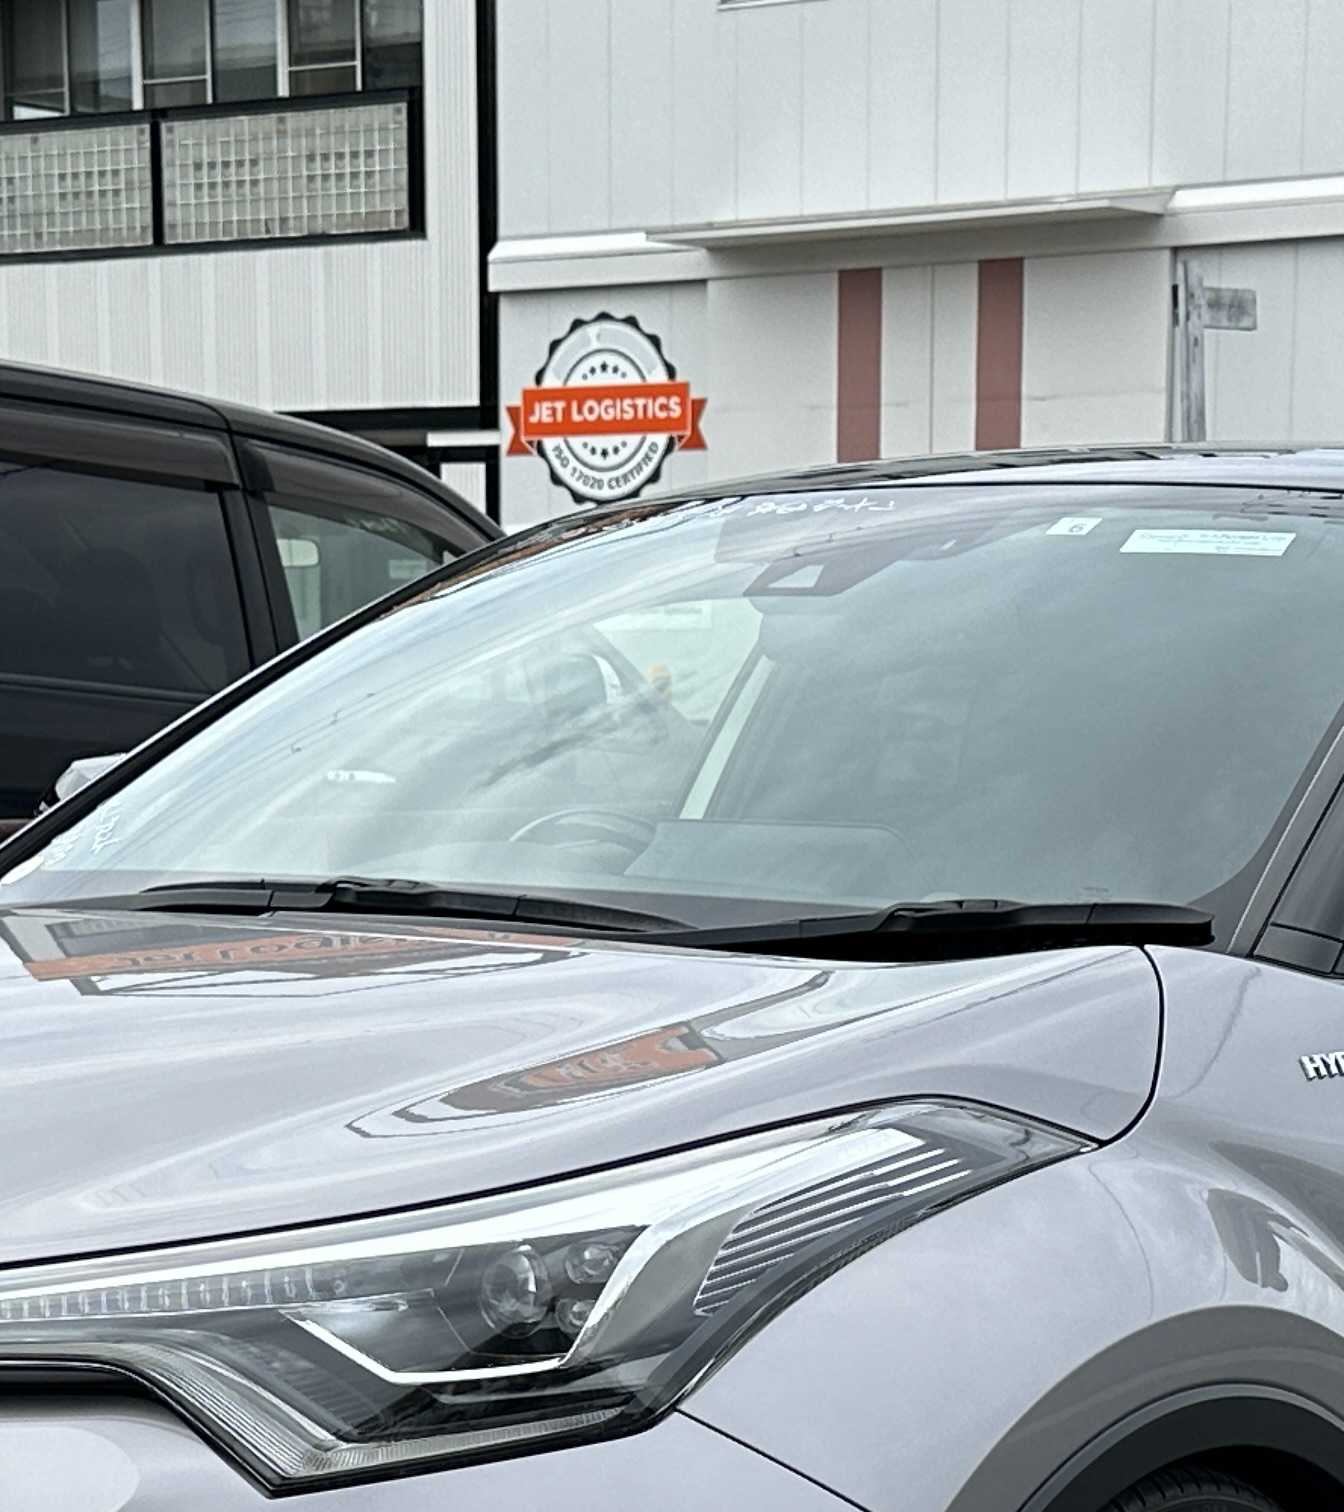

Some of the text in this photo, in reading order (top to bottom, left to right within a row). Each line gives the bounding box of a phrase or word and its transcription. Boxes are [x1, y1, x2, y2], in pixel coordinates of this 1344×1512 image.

[529, 396, 682, 423] JET LOGISTICS
[570, 466, 605, 490] 17020
